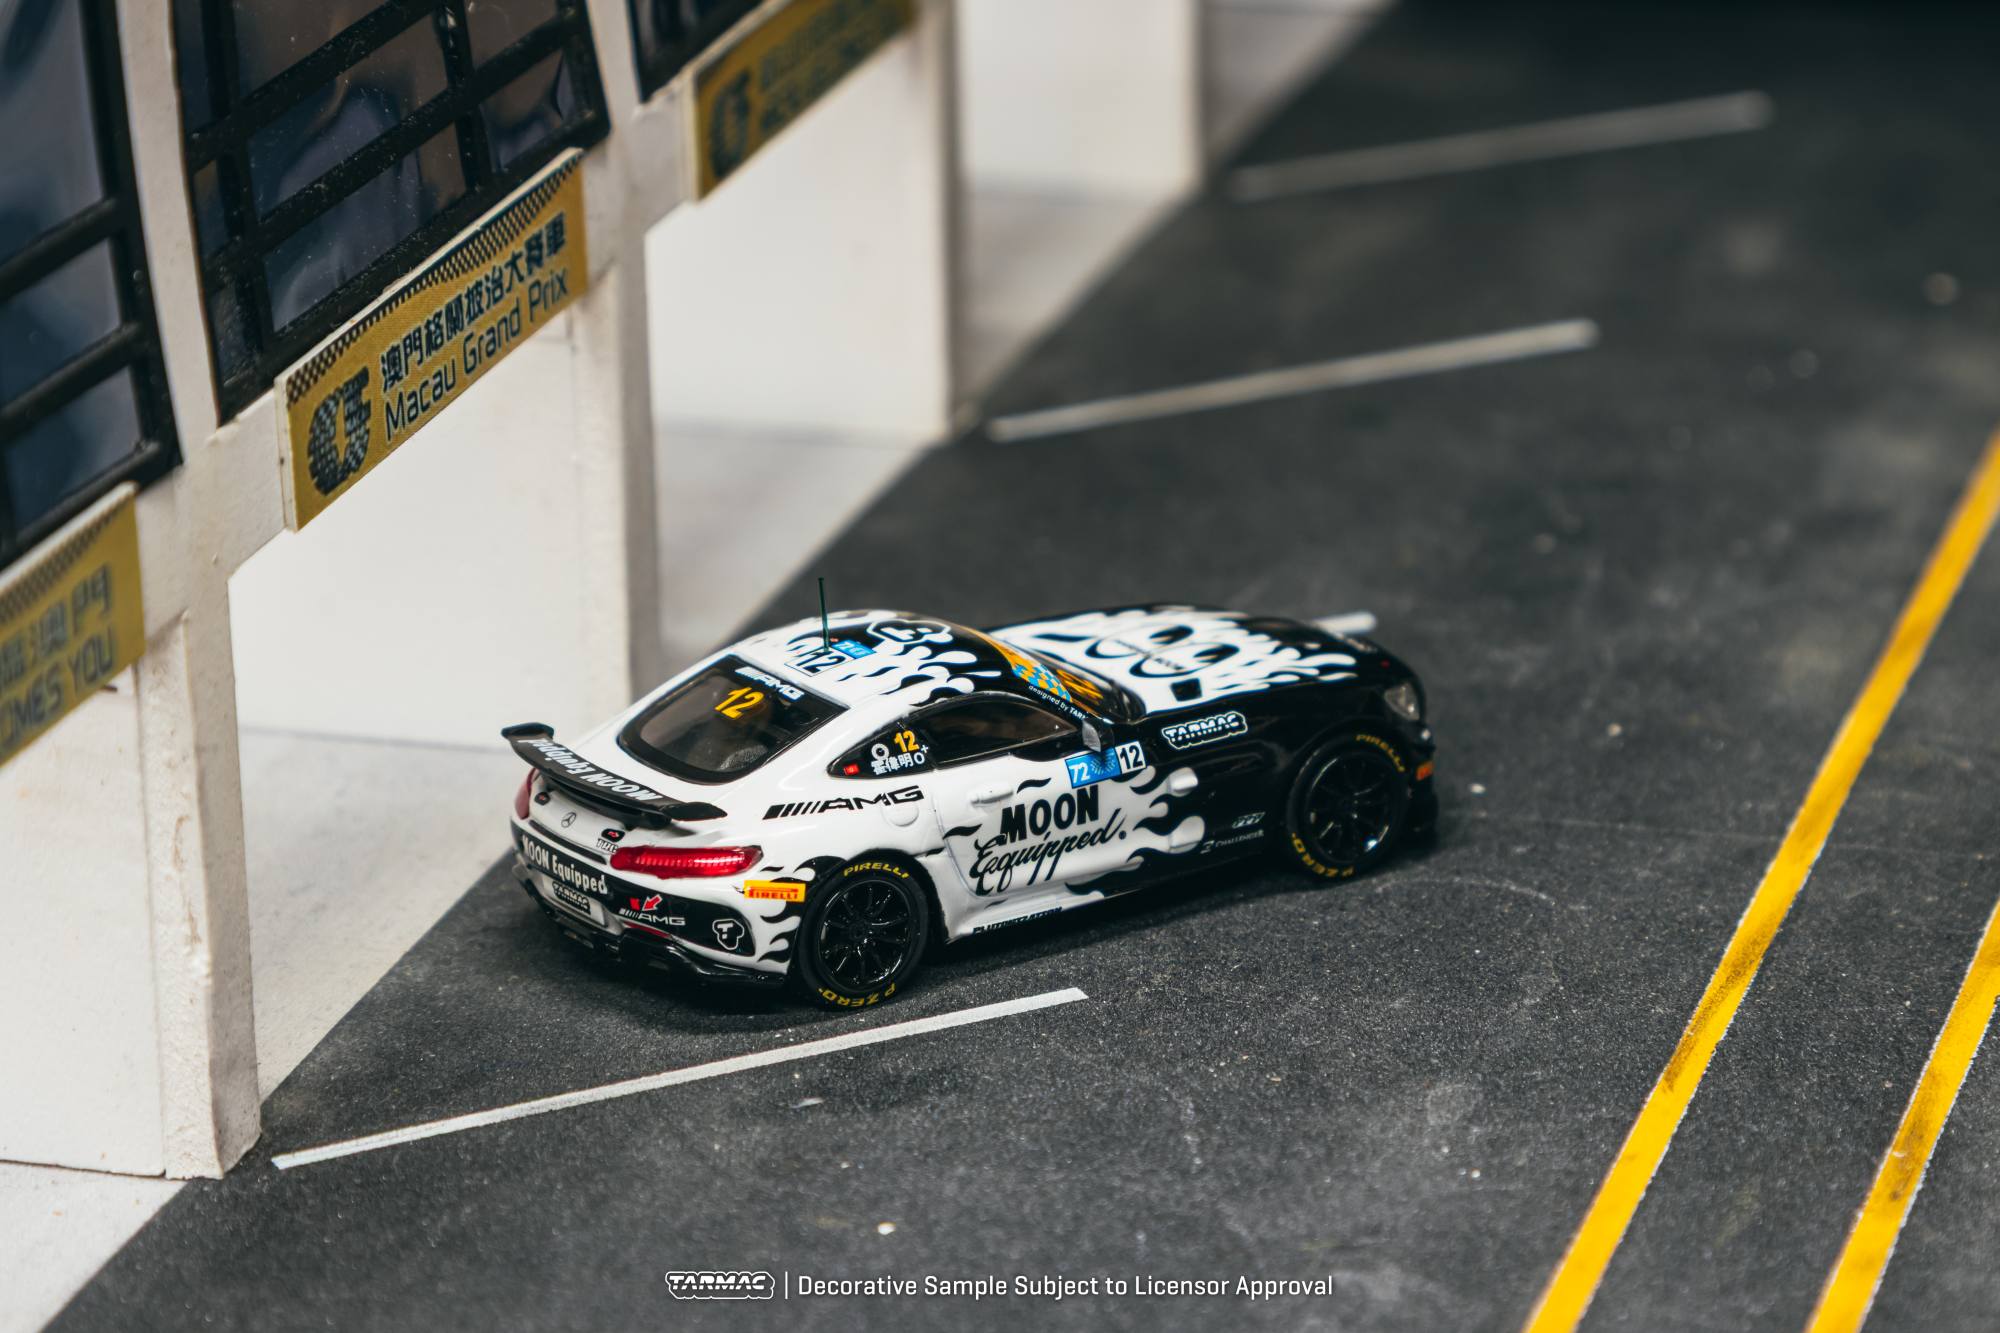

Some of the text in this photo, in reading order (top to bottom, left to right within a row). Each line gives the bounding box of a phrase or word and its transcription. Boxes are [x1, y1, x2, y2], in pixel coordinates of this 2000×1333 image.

[384, 267, 568, 442] Macau Grand Prix
[68, 626, 114, 696] YOU
[797, 651, 845, 673] 12
[714, 687, 764, 718] 12
[1028, 685, 1060, 705] designed
[1060, 701, 1070, 714] by
[894, 730, 920, 753] 12
[1165, 714, 1240, 743] TARMAC
[1120, 745, 1143, 769] 12
[582, 771, 663, 801] MOON
[1069, 762, 1090, 784] 72
[818, 785, 924, 813] AMG
[1000, 785, 1099, 844] MOON
[552, 854, 608, 895] Equipped
[843, 861, 910, 880] PIRELLI
[749, 887, 799, 900] PIRELLI
[639, 912, 686, 926] AMG
